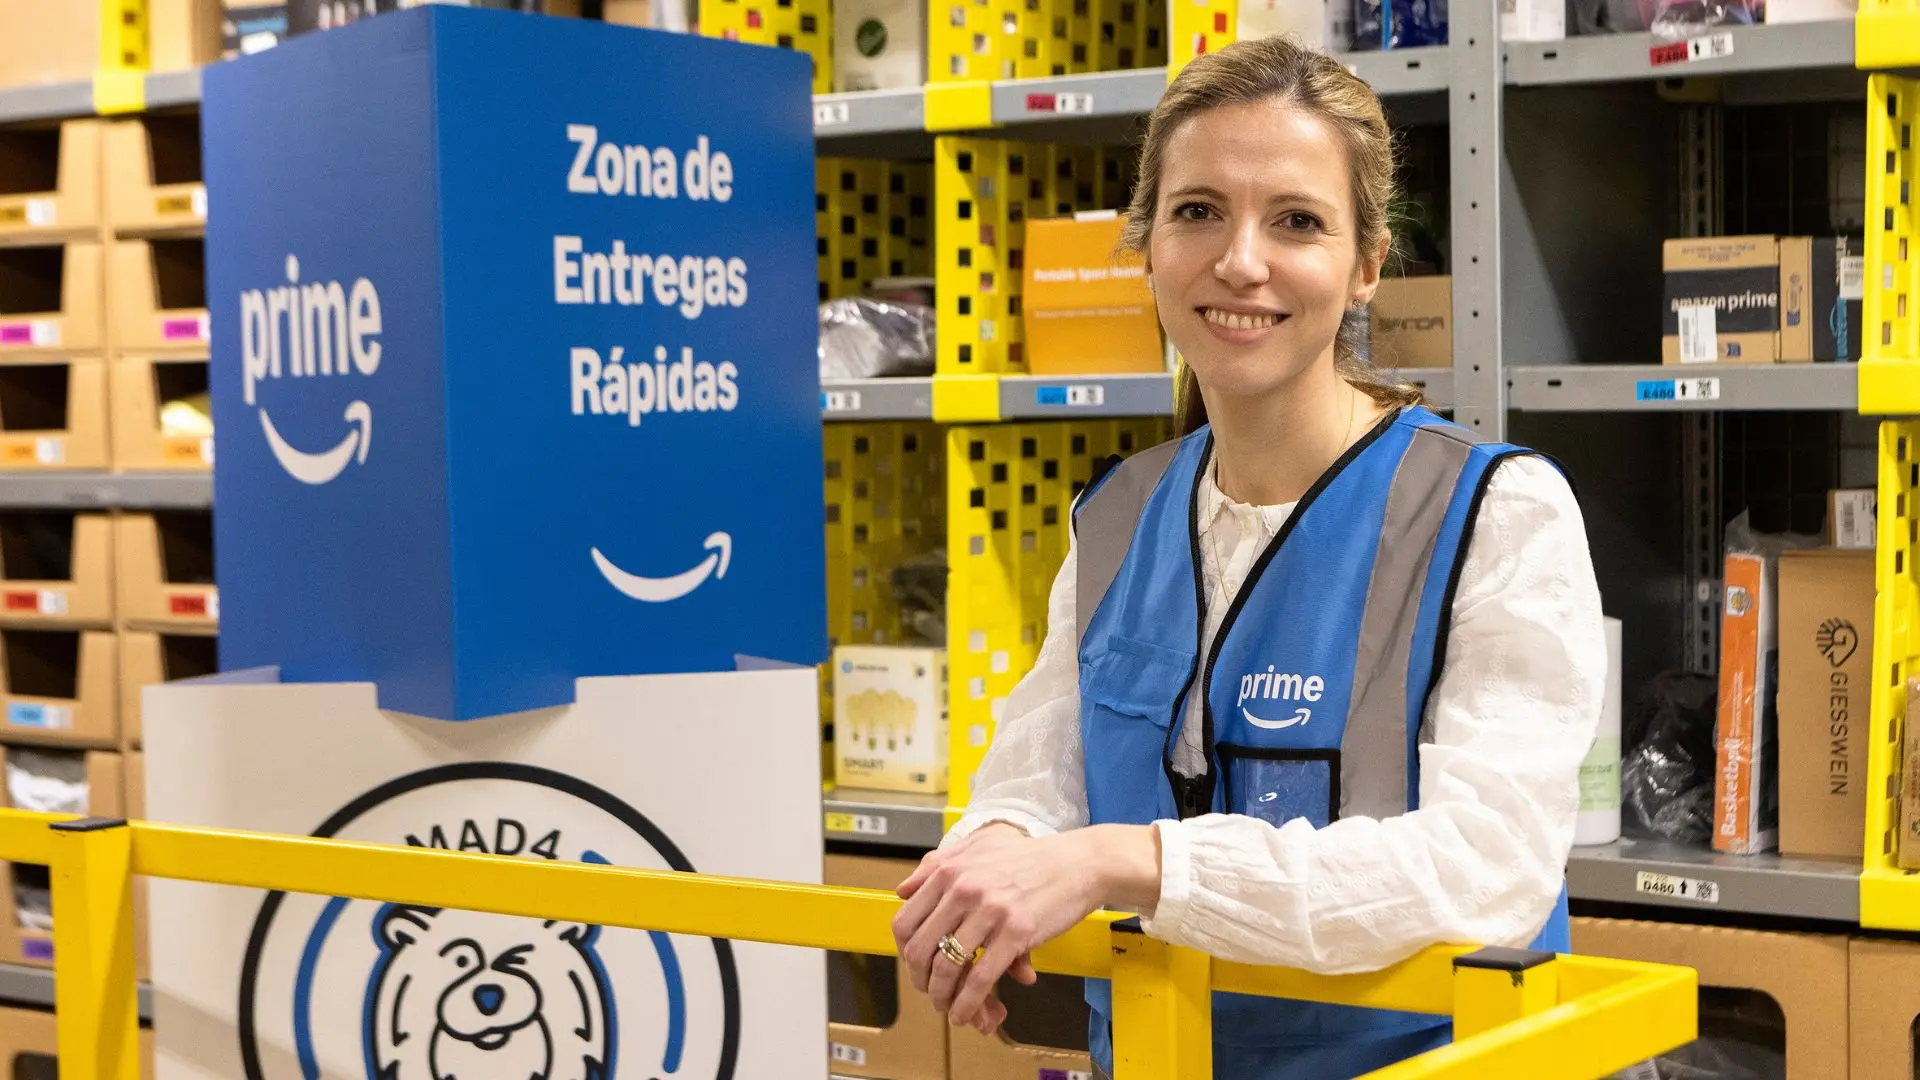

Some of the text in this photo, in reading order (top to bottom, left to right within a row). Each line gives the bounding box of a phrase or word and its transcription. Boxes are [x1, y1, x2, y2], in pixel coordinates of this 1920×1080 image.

[566, 123, 733, 202] Zona de
[554, 235, 748, 319] Entregas
[1671, 289, 1778, 314] amazon prime
[239, 253, 383, 406] prime
[570, 346, 739, 427] Rápidas
[1237, 664, 1325, 707] prime
[1830, 671, 1849, 796] GIESSWEIN
[1643, 880, 1676, 894] D480
